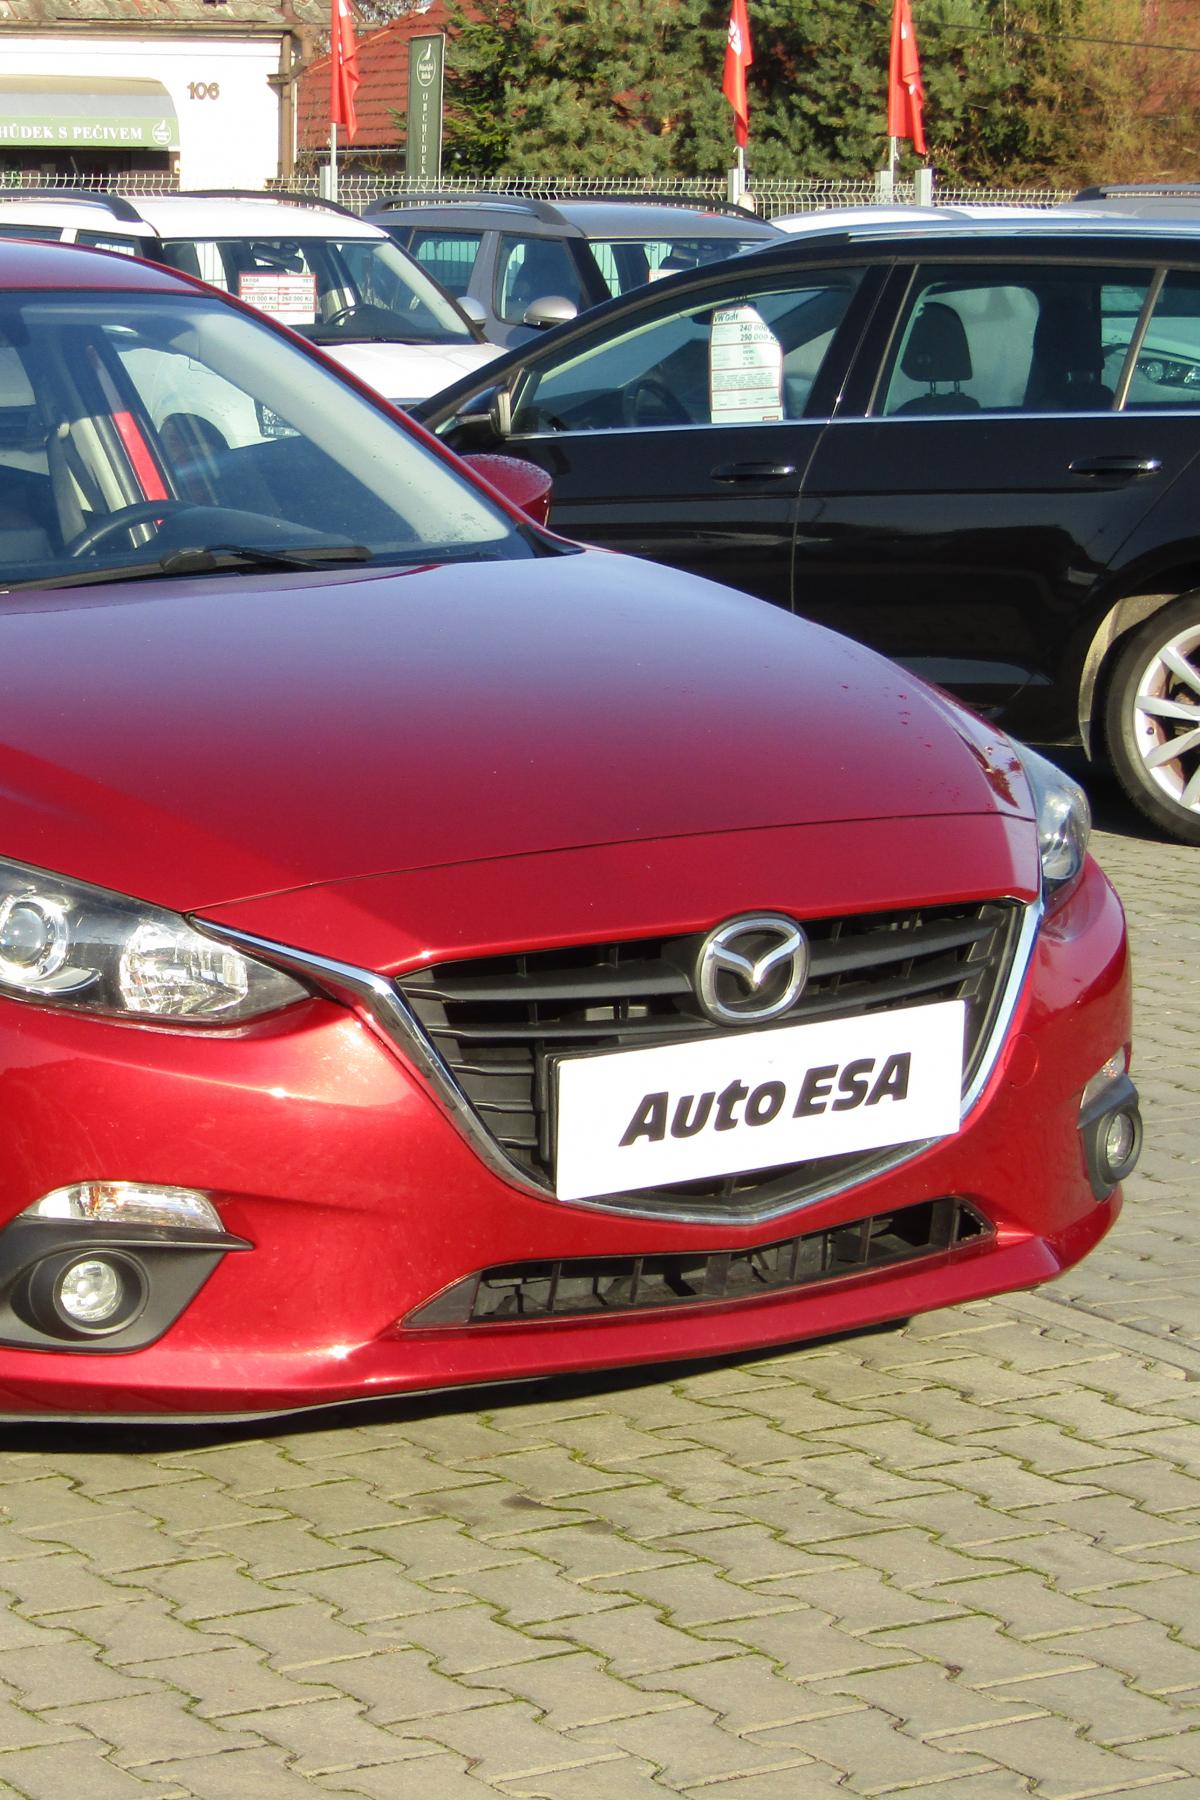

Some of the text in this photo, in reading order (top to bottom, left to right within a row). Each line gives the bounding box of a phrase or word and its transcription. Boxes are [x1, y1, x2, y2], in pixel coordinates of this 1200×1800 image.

[187, 81, 220, 101] 106
[58, 126, 68, 139] S
[72, 124, 143, 140] PEČIVEM
[618, 1052, 912, 1147] Auto ESA
